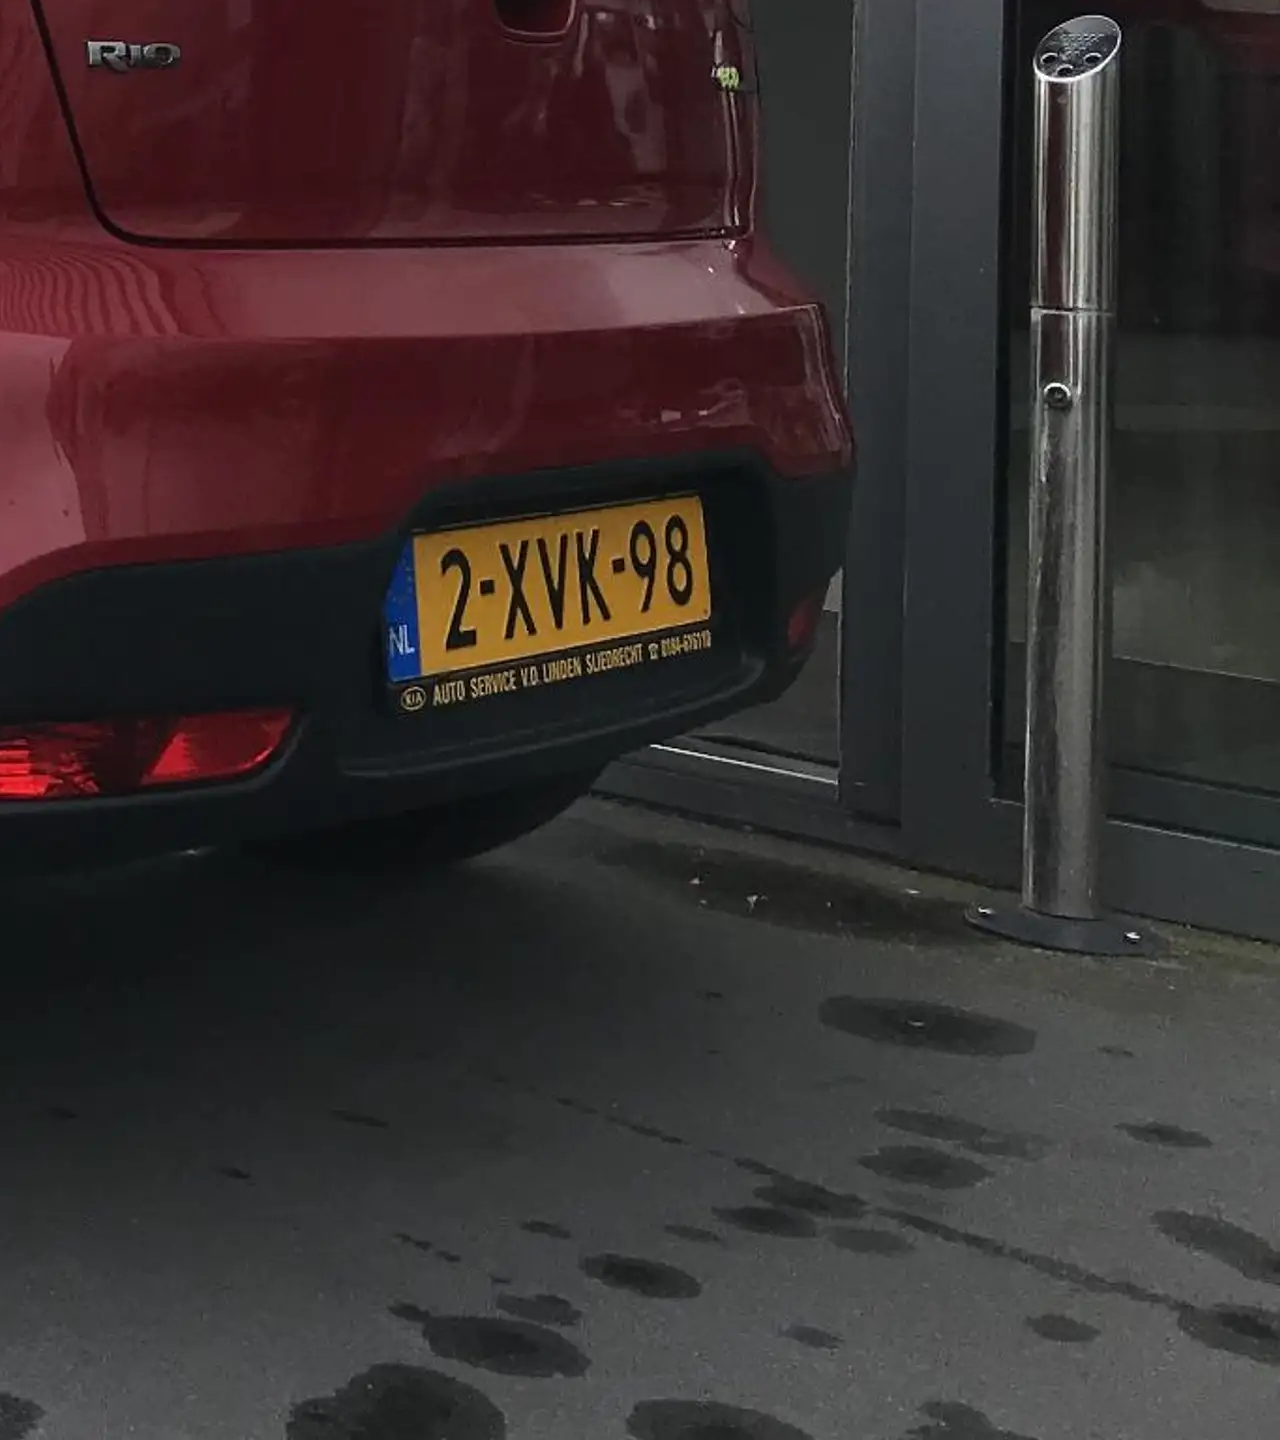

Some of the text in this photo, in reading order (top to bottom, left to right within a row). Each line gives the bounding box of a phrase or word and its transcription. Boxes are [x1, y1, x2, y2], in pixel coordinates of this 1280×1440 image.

[440, 514, 694, 652] 2-XVK-98
[388, 624, 416, 659] NL
[403, 688, 425, 709] KIA
[432, 679, 466, 707] AUTO
[470, 671, 517, 699] SERVICE
[543, 658, 583, 684] LINDEN
